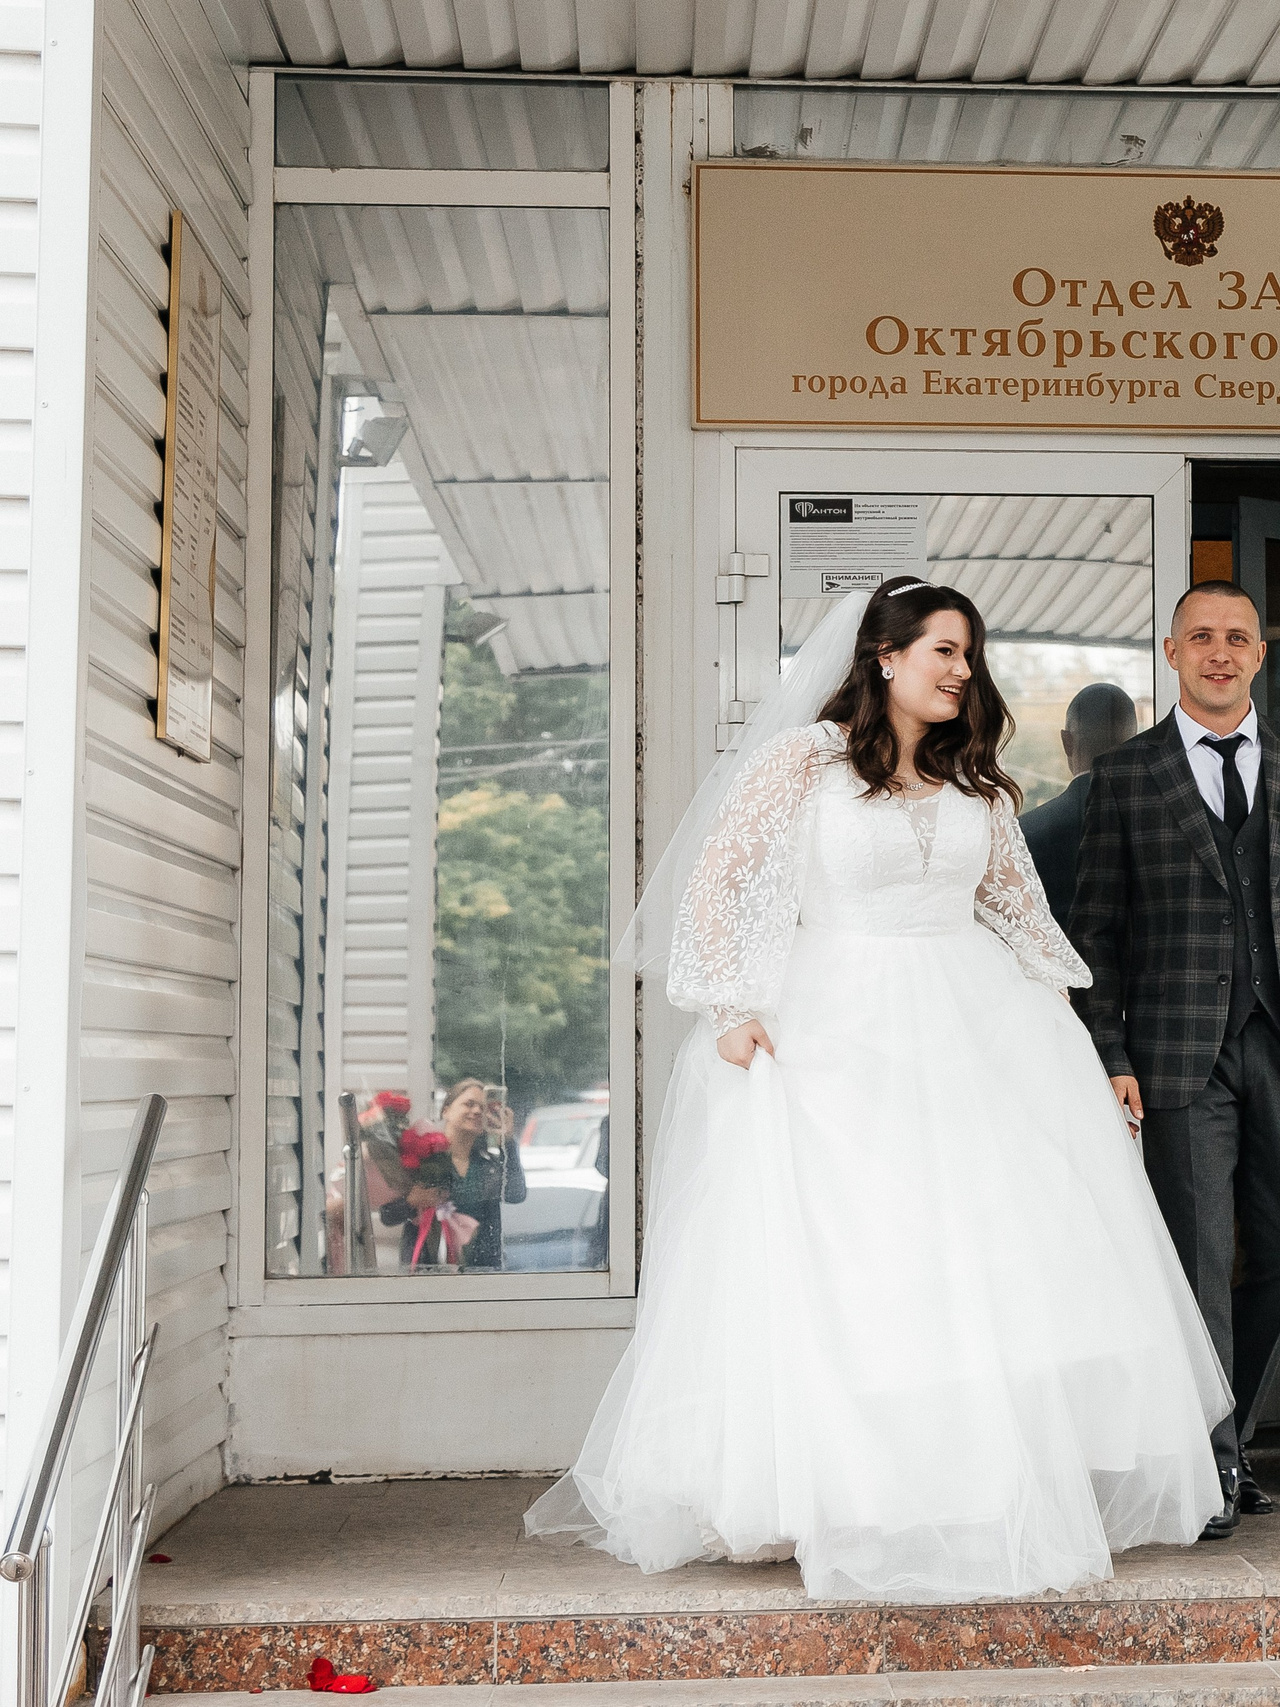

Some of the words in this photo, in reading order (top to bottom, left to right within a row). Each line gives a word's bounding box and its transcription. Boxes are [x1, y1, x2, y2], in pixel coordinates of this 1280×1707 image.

[1012, 267, 1191, 317] Отдел
[866, 315, 1279, 368] Октябрьского
[791, 374, 908, 400] города
[922, 370, 1182, 404] Екатеринбурга
